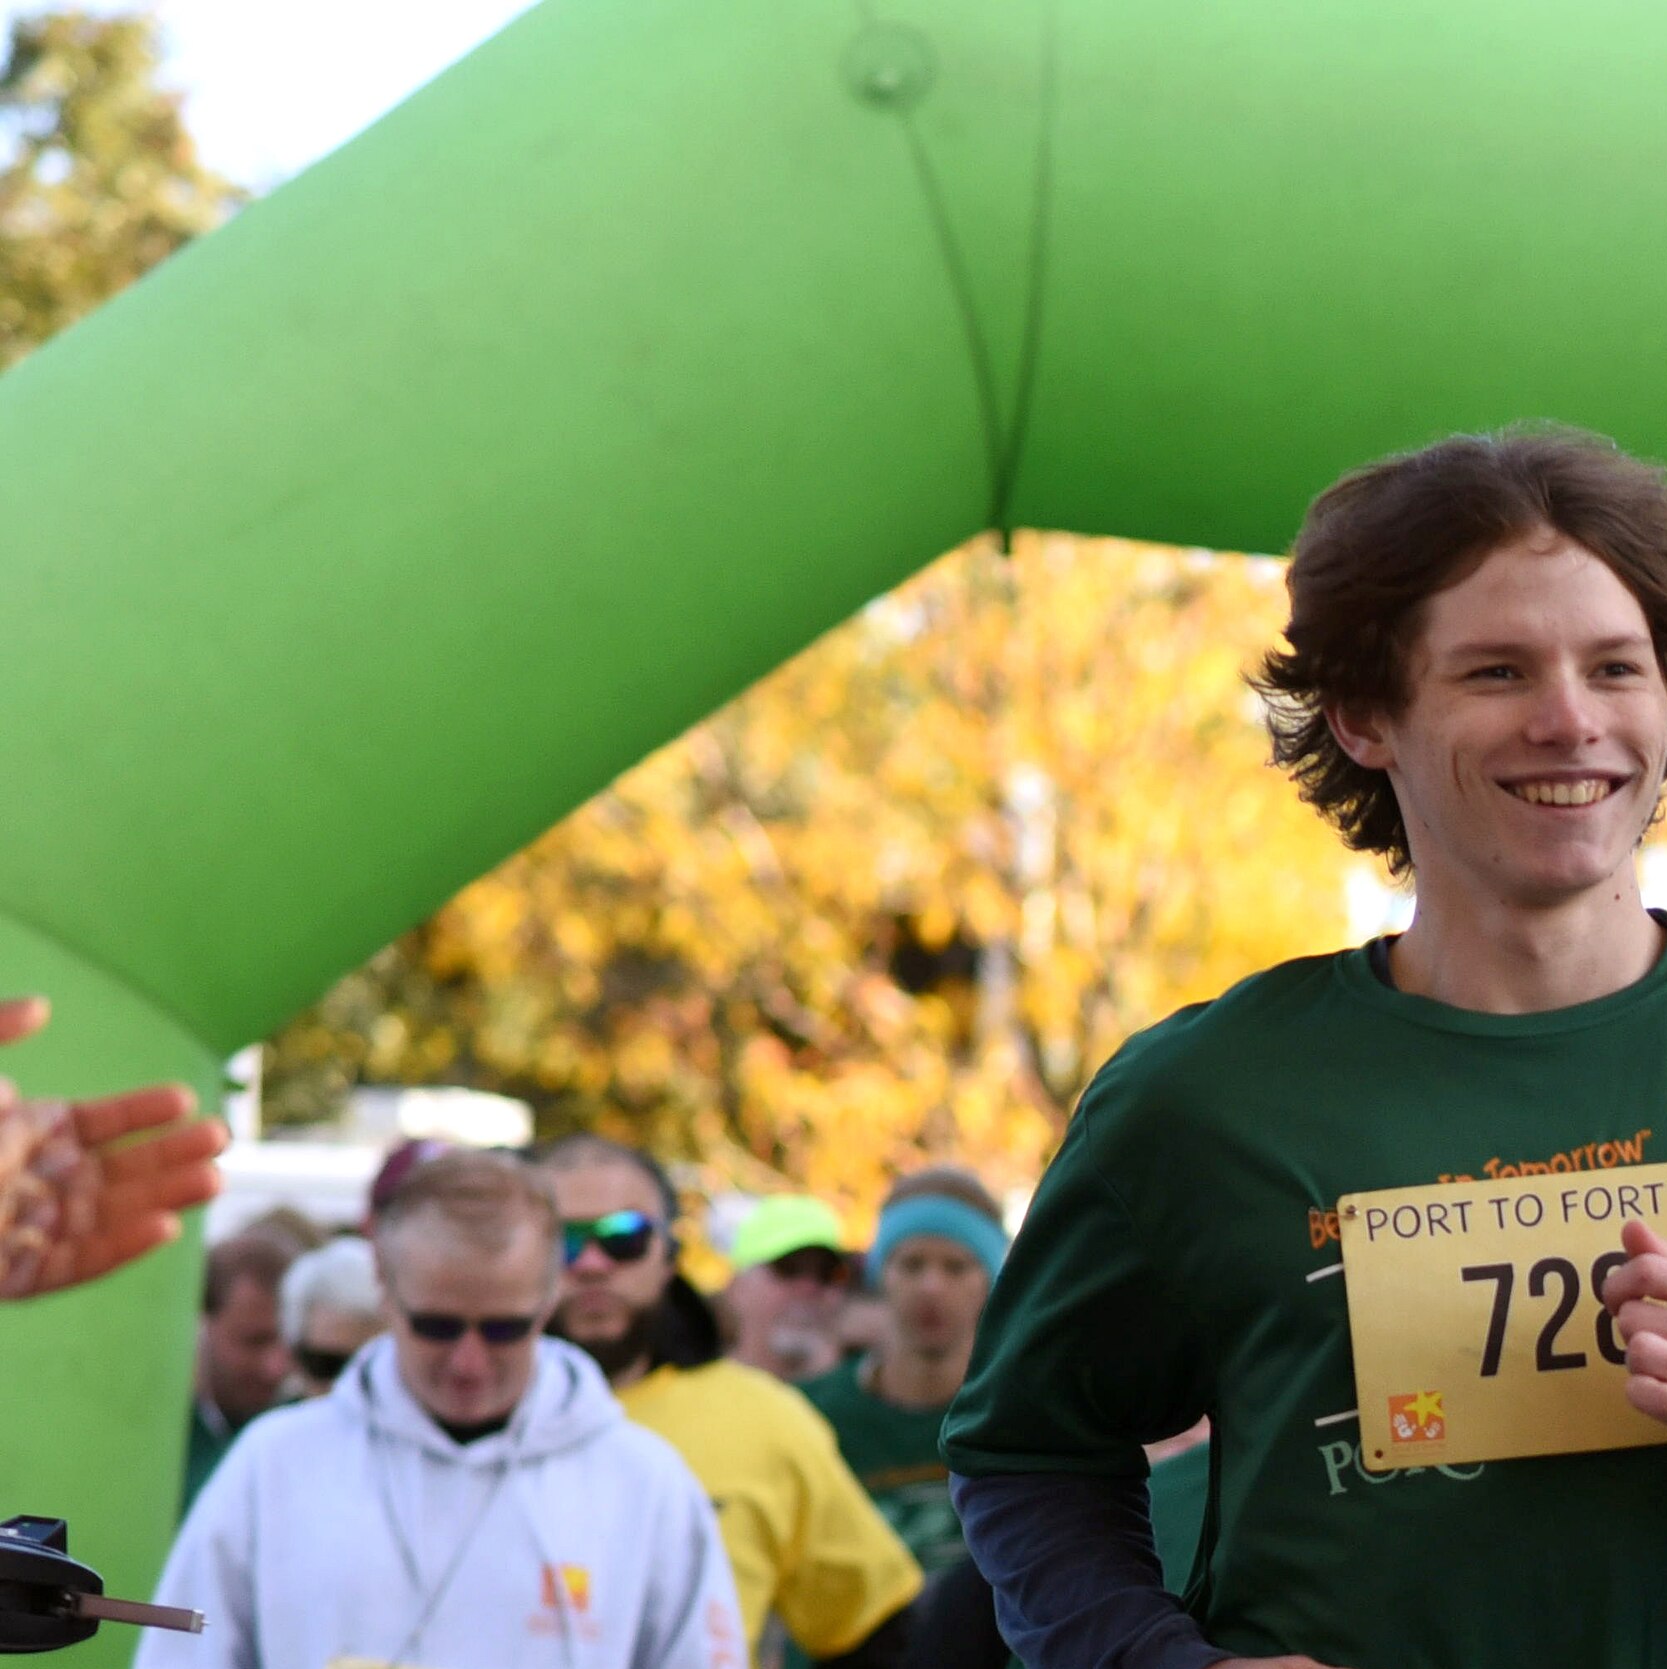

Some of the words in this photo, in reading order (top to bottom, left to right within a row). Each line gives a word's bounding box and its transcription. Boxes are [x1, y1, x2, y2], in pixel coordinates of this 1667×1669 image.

[1366, 1202, 1474, 1242] PORT
[1489, 1193, 1544, 1230] TO
[1562, 1183, 1664, 1224] FORT
